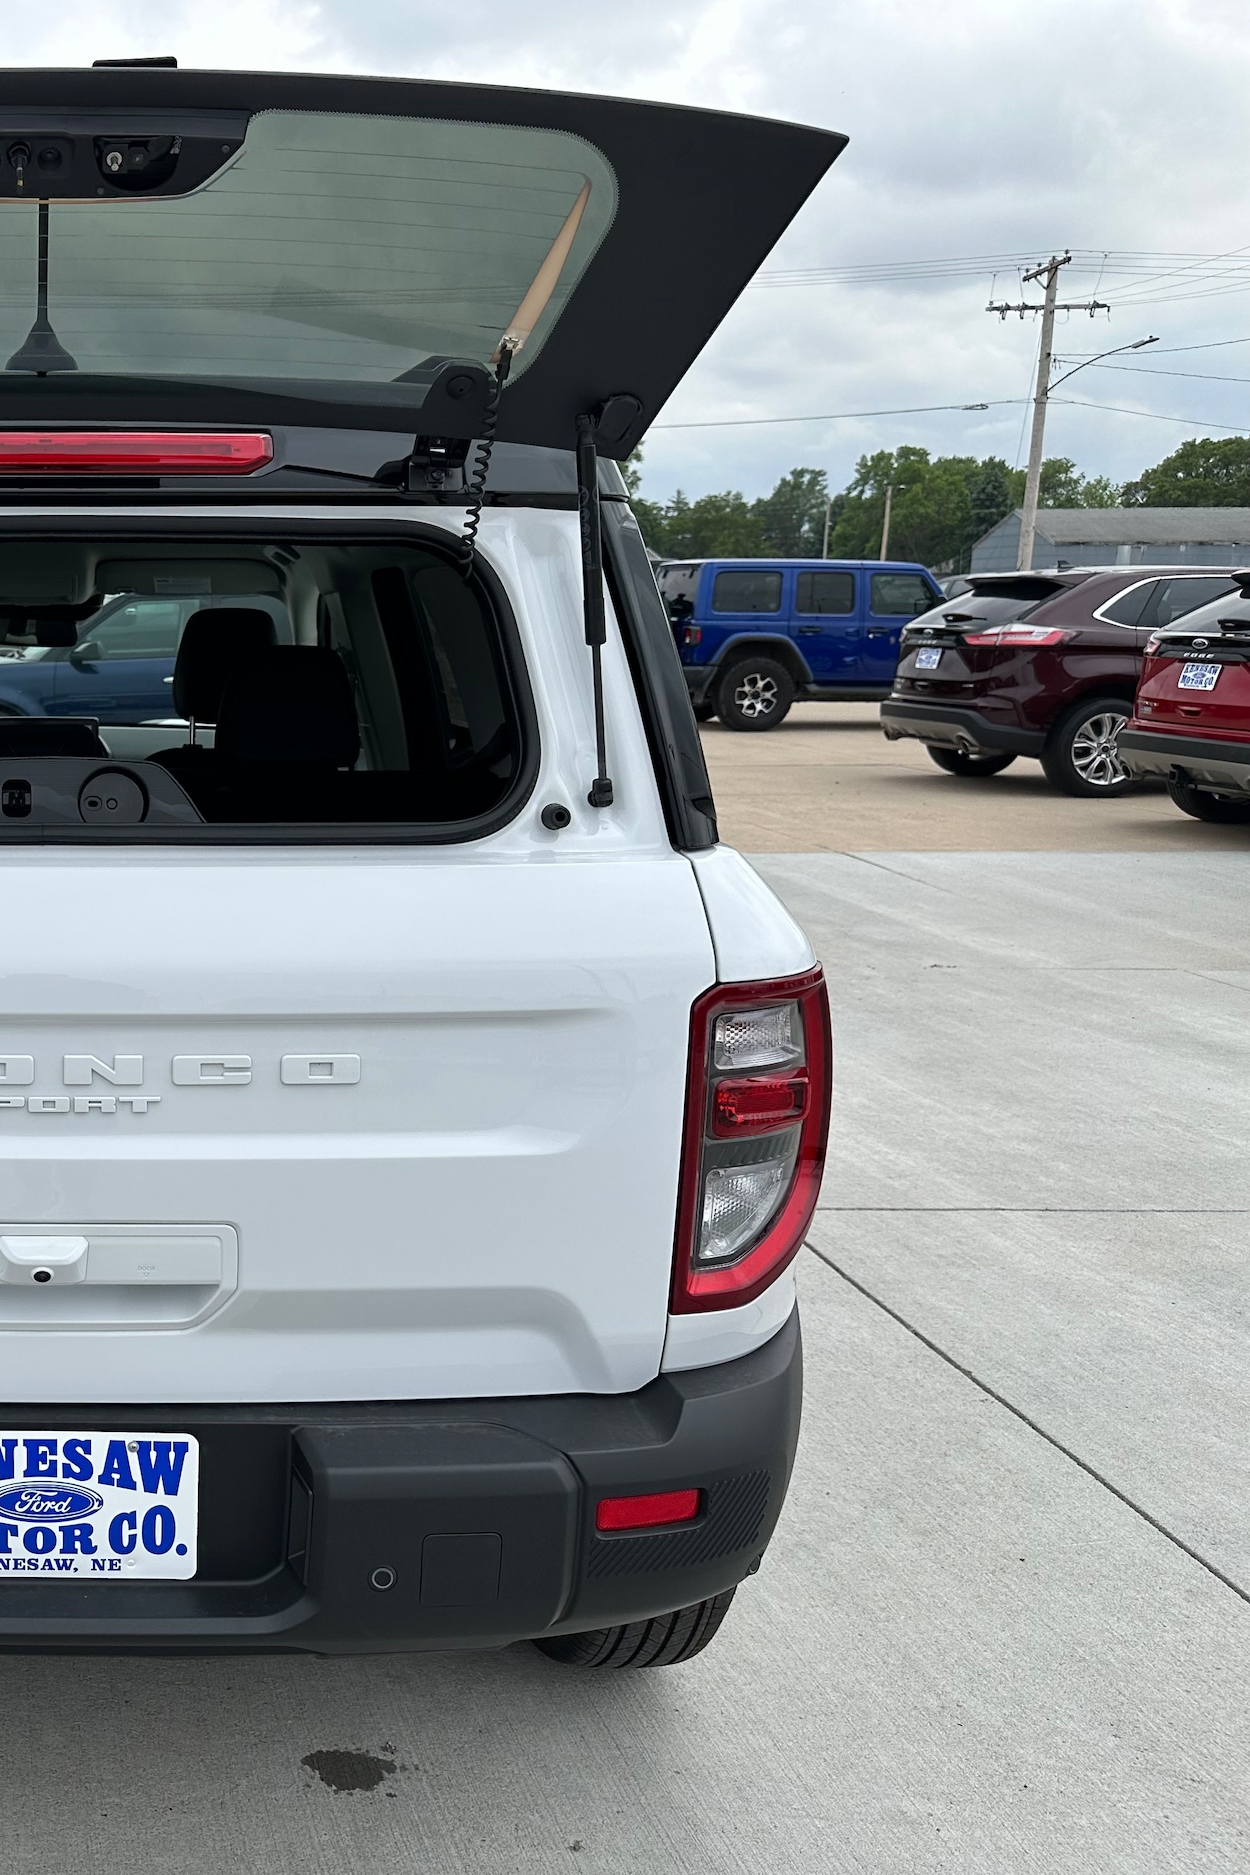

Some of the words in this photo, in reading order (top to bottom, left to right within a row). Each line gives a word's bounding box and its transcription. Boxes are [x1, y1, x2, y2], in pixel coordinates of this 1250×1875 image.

[14, 1489, 73, 1514] Ford
[108, 1504, 188, 1556] CO.
[90, 1558, 121, 1572] NE
